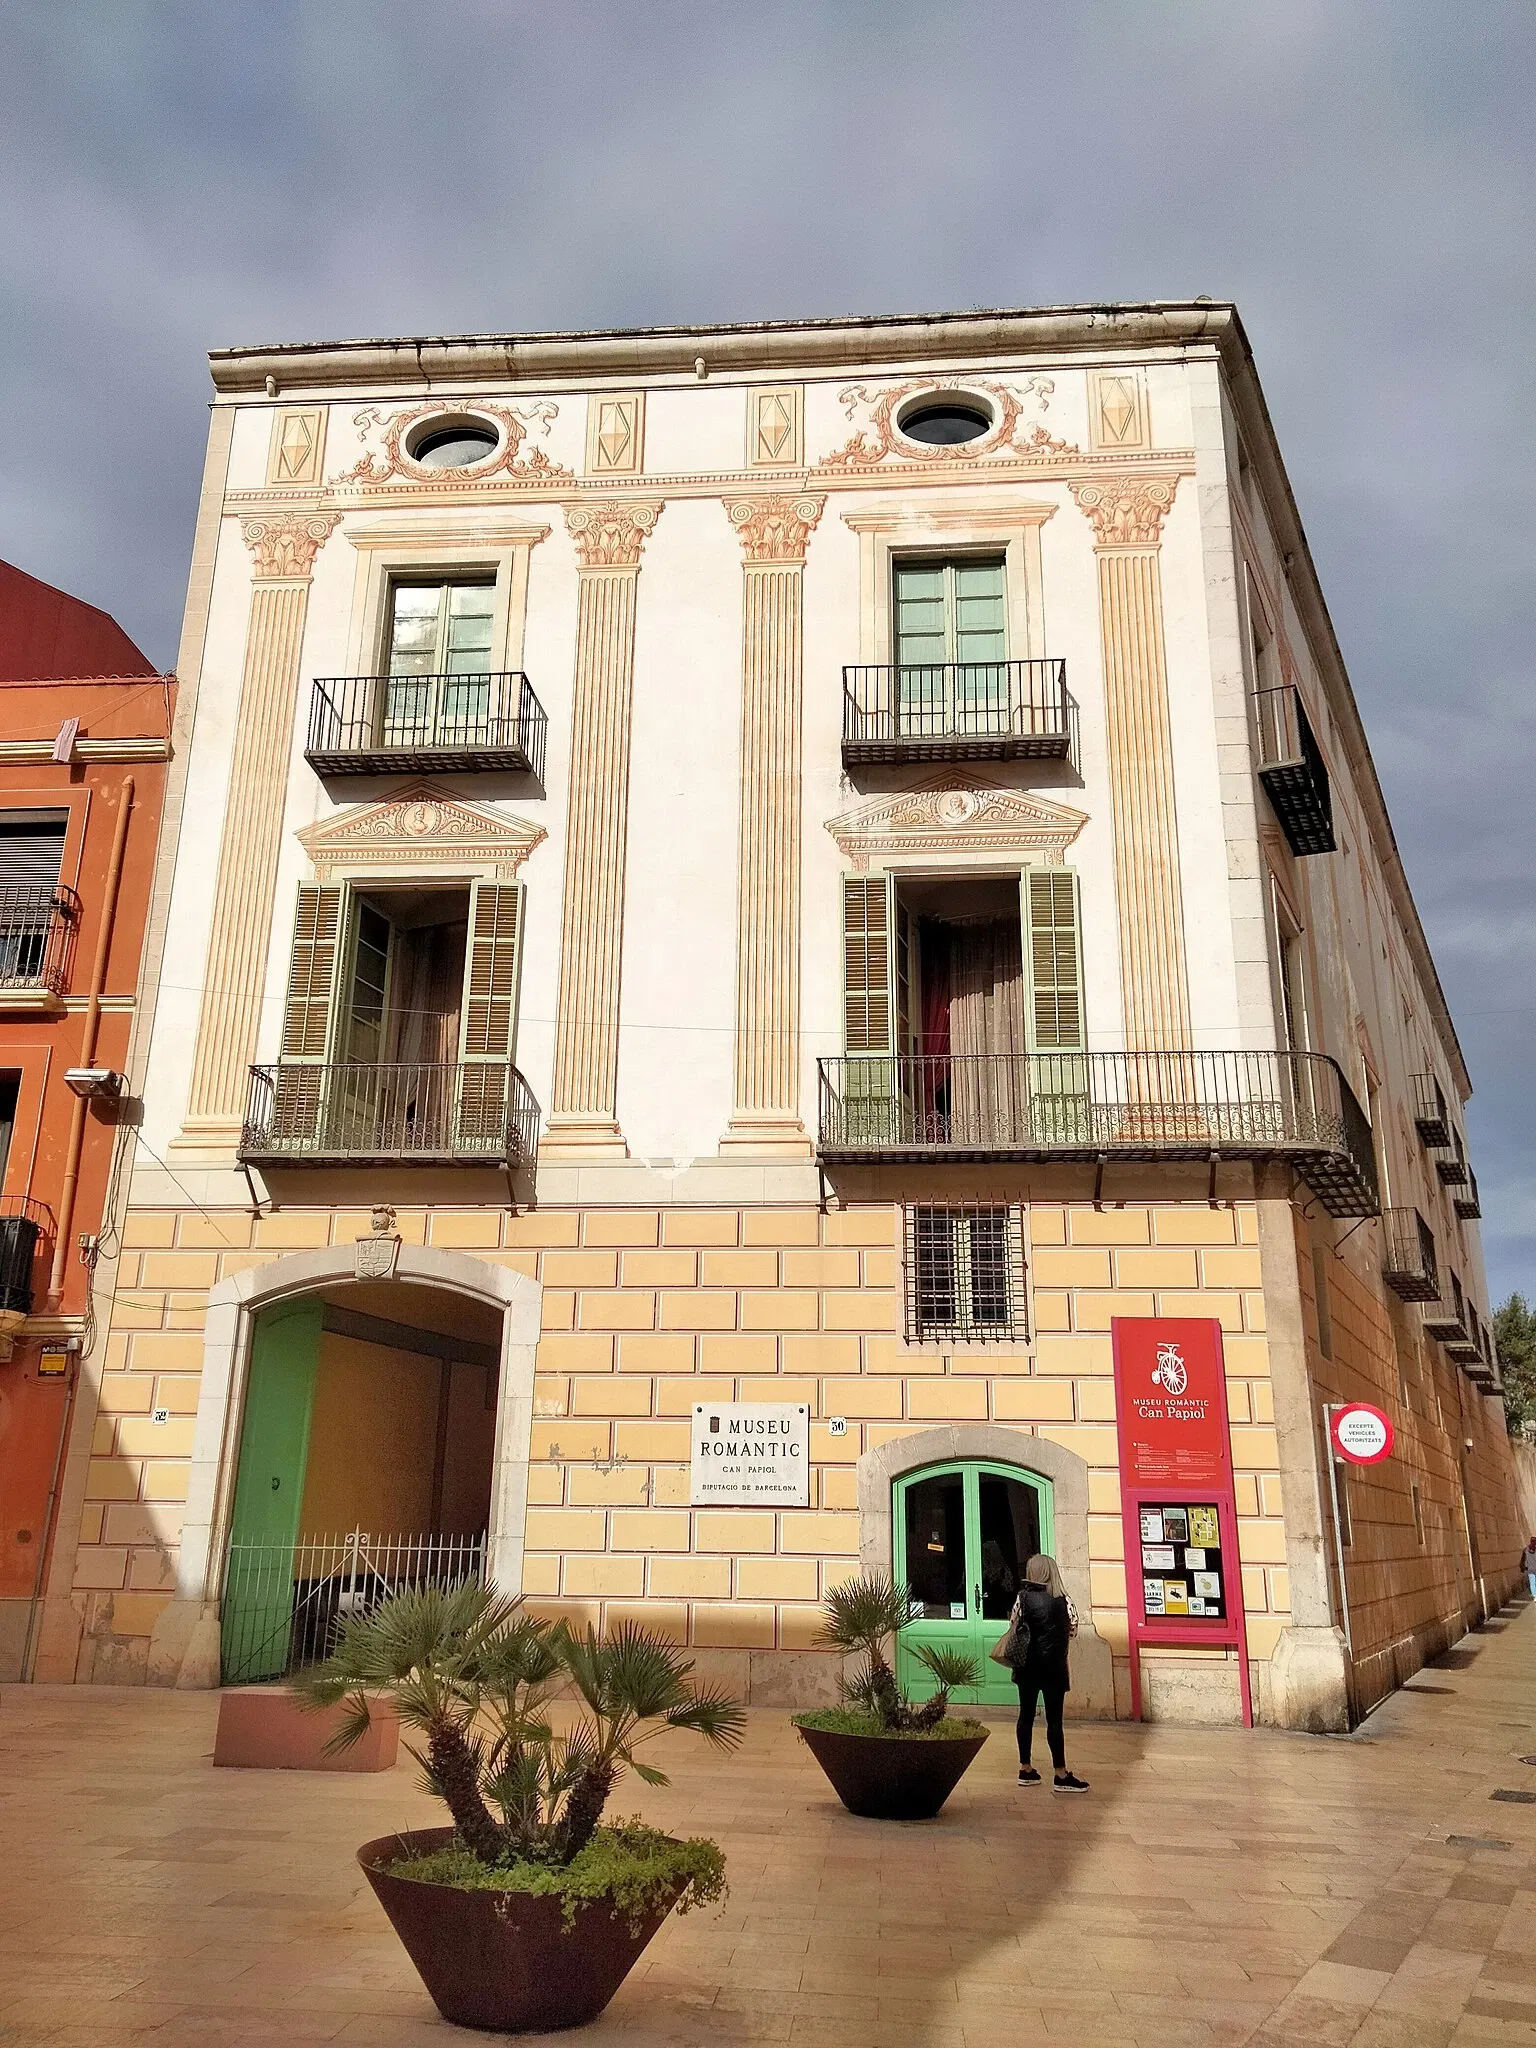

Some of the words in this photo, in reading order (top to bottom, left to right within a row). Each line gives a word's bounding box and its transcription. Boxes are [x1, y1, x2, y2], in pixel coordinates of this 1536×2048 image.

[155, 1411, 167, 1421] 32
[1139, 1406, 1163, 1418] Can
[1167, 1406, 1205, 1420] Papiol
[729, 1420, 791, 1434] MUSEU
[831, 1421, 844, 1431] 30
[701, 1440, 800, 1457] ROMÀNTIC
[748, 1466, 777, 1474] PAPIOL
[755, 1484, 797, 1492] BARCELONA
